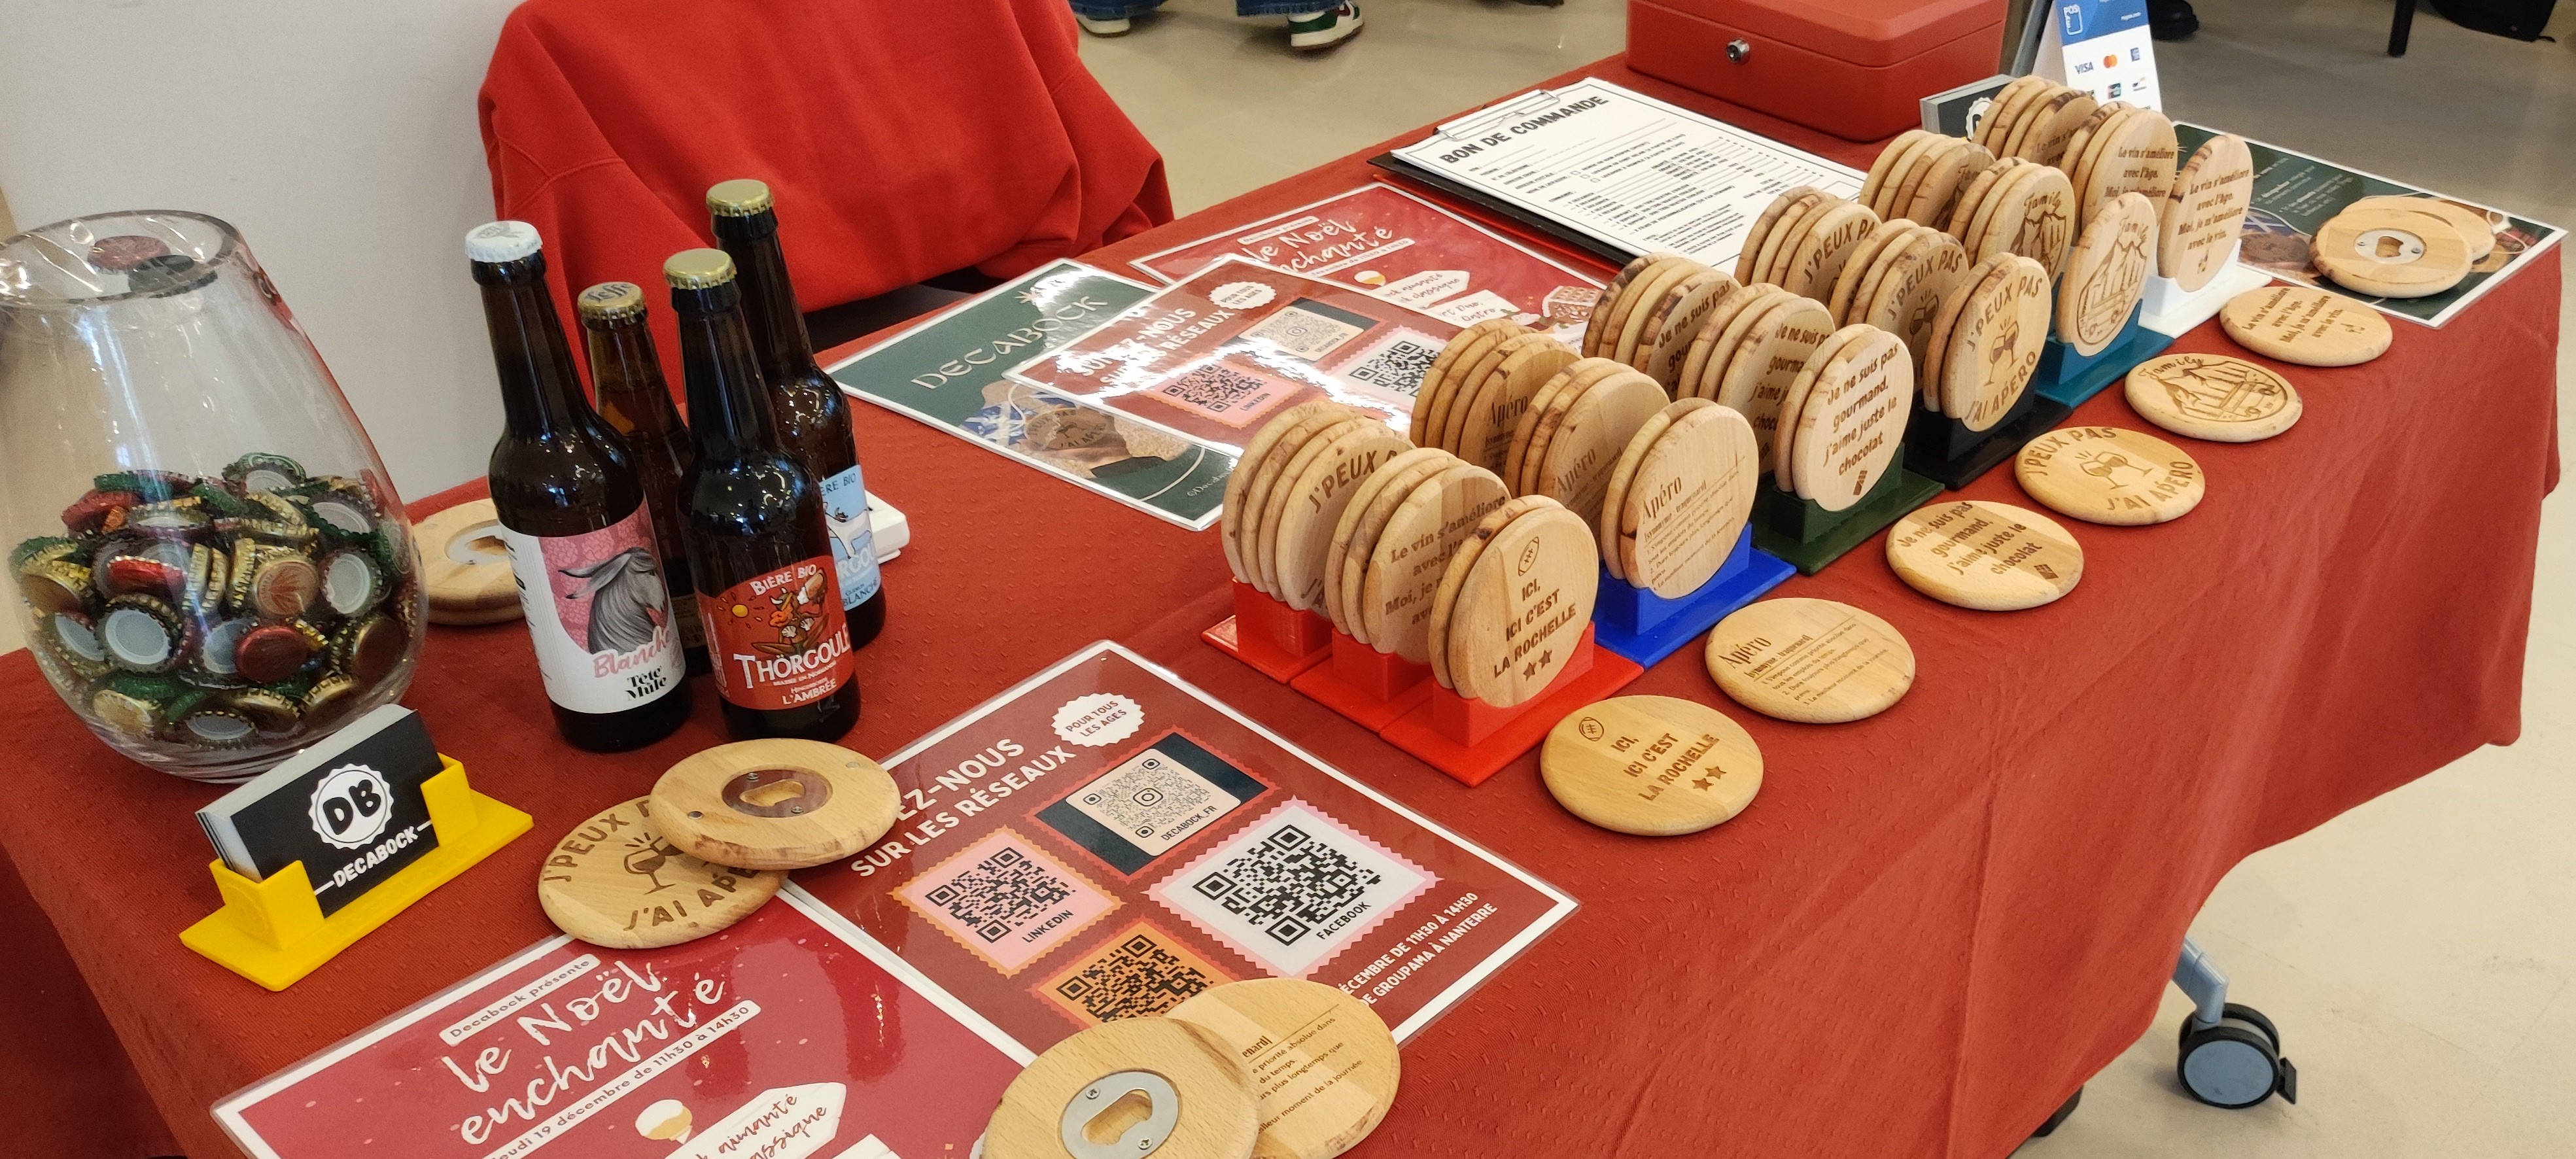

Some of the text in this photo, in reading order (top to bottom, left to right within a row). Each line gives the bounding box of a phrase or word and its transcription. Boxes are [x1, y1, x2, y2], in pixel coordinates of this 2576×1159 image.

[2075, 61, 2093, 74] VISA
[1439, 96, 1609, 164] BON DE COMMANDE
[2123, 169, 2140, 178] avec
[2129, 148, 2139, 158] vin
[2024, 191, 2062, 216] Family
[2189, 184, 2199, 195] Le
[2201, 179, 2212, 191] vin
[2197, 198, 2214, 211] avec
[1279, 219, 1357, 249] Noël
[1279, 226, 1393, 272] nchanté
[1804, 222, 1853, 285] J'PEUX
[2187, 237, 2205, 251] avec
[2206, 233, 2213, 244] le
[1887, 250, 1962, 321] J'PEUX PAS
[1160, 309, 1235, 350] RÉSEAUX
[1658, 280, 1731, 349] Je ne suis pas
[1775, 322, 1788, 339] Je
[1787, 328, 1801, 341] ne
[1800, 328, 1819, 345] suis
[1966, 275, 2043, 353] J'PEUX PAS
[2251, 313, 2266, 322] vin
[2272, 314, 2289, 328] avec
[2312, 324, 2329, 338] avec
[912, 296, 1108, 389] DECABOCK
[1828, 343, 1899, 406] Je ne suis pas
[2138, 355, 2204, 380] Family
[1748, 382, 1781, 403] j'aime
[1964, 396, 1988, 423] J'AI
[1823, 396, 1897, 468] j'aime juste le
[1839, 430, 1883, 476] chocolat
[2023, 428, 2117, 476] J'PEUX PAS
[843, 472, 856, 487] BIO
[1309, 450, 1377, 514] J'PEUX
[1643, 477, 1682, 524] Apéro
[2106, 460, 2194, 511] J'AI APÉRO
[1391, 547, 1408, 564] Le
[1411, 533, 1434, 552] vin
[1437, 496, 1506, 539] s'améliore
[1896, 502, 1974, 548] Je ne suis pas
[1930, 518, 1994, 558] gourmand,
[1412, 554, 1446, 577] avec
[1947, 523, 2027, 576] j'aime juste le
[1990, 542, 2042, 575] chocolat
[750, 564, 817, 596] BIÈRE BIO
[1384, 582, 1436, 615] Moi, je
[1520, 578, 1541, 602] ICI,
[1505, 588, 1560, 642] ICI C'EST
[592, 629, 672, 679] Blanche
[1493, 602, 1577, 679] LA ROCHELLE
[1718, 636, 1771, 669] Apéro
[624, 676, 668, 702] Mule
[627, 665, 663, 689] Tête
[1065, 700, 1119, 733] POUR TOUS
[1080, 708, 1127, 738] LES AGES
[1610, 736, 1640, 753] ICI,
[1623, 733, 1679, 778] ICI C'EST
[1637, 733, 1720, 801] LA ROCHELLE
[897, 737, 1026, 823] EZ-NOUS
[322, 779, 382, 836] DB
[850, 744, 1076, 878] SUR LES RÉSEAUX
[332, 825, 420, 888] DECABOCK
[542, 812, 631, 883] J'PEUX
[623, 900, 688, 933] J'AI
[1021, 908, 1075, 943] LINKEDIN
[1316, 901, 1372, 941] FACEBOOK
[1338, 892, 1478, 995] ÉCEMBRE DE 11H30 À 14H30
[1373, 950, 1436, 997] GROUPAMA
[1428, 942, 1446, 954] À
[1439, 903, 1499, 946] NANTERRE
[450, 960, 590, 1037] Decabock présente
[517, 960, 661, 1047] Noël
[461, 972, 725, 1145] enchanté
[1259, 1018, 1336, 1071] priorité absolue dans
[1272, 1041, 1344, 1092] plus longtemps que
[534, 1006, 750, 1140] 19 décembre de 11h30 à 14h30
[1259, 1059, 1298, 1084] du temps.
[1281, 1093, 1314, 1116] moment
[1314, 1085, 1326, 1094] de
[718, 1093, 799, 1154] aimanté
